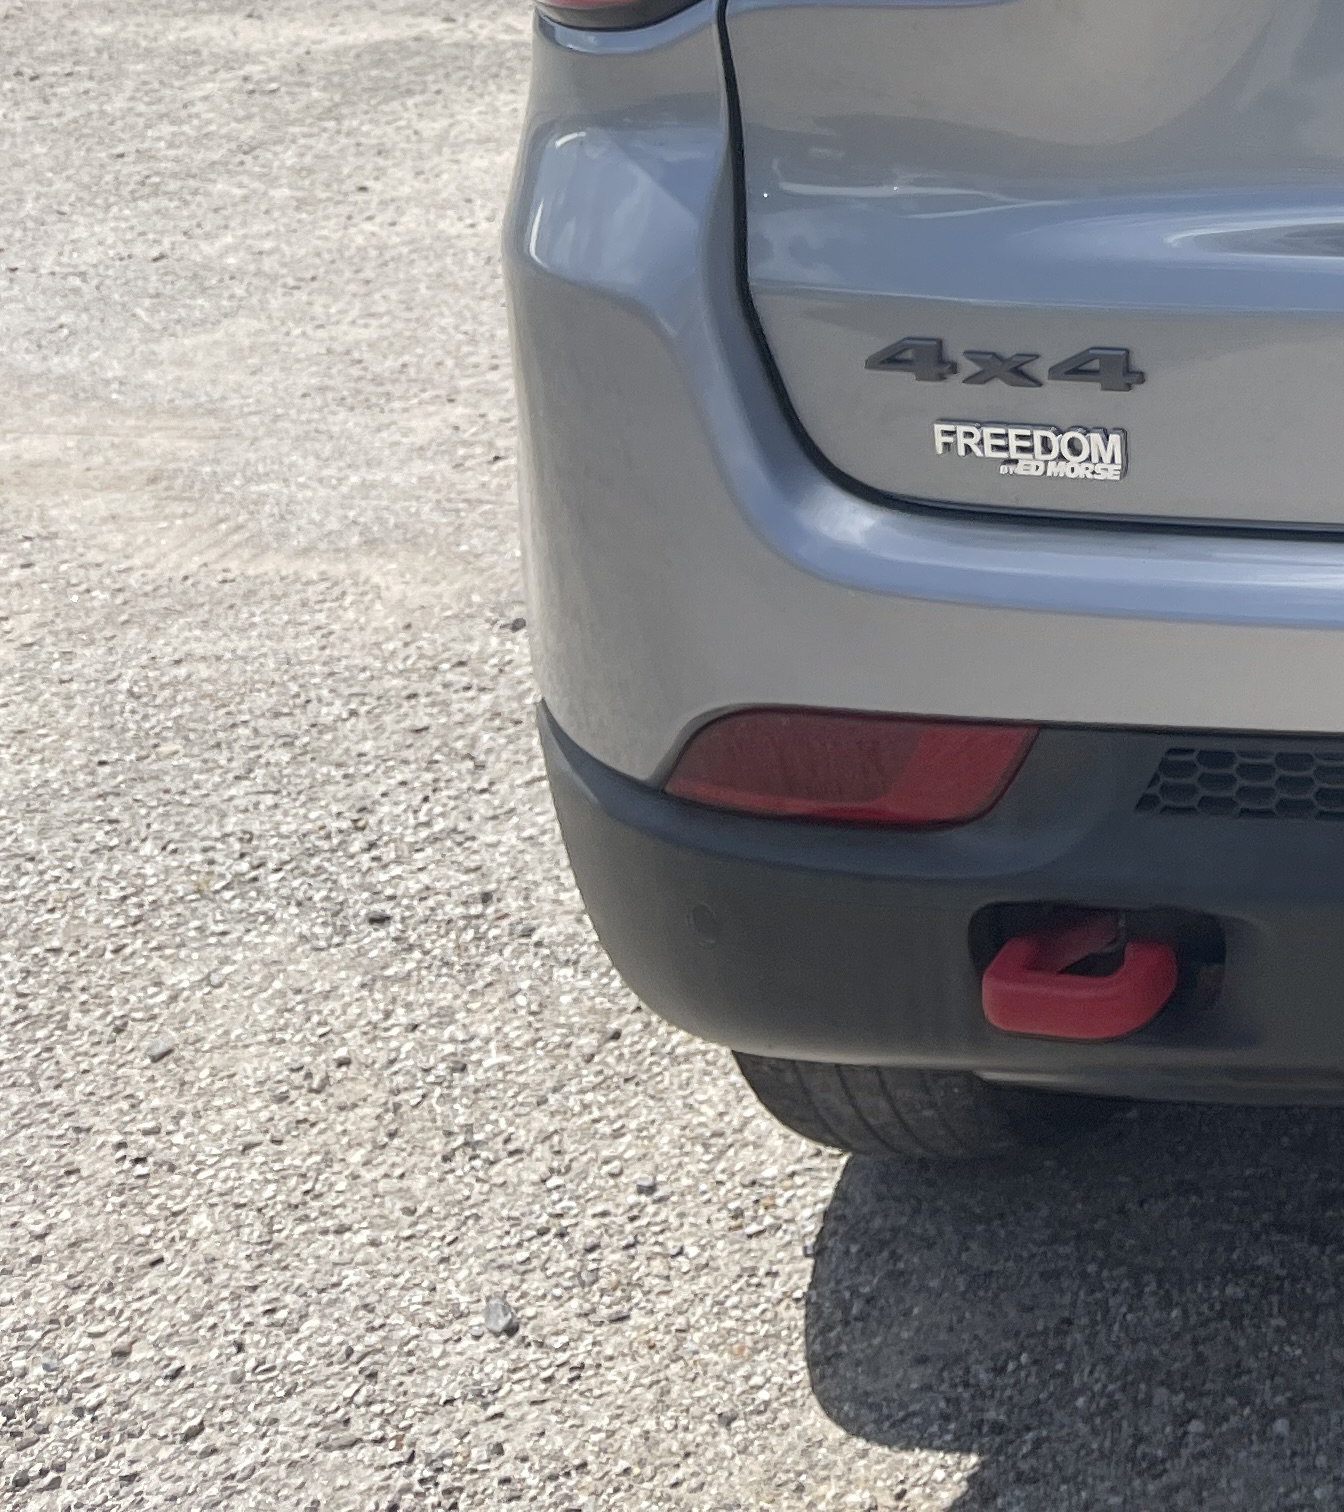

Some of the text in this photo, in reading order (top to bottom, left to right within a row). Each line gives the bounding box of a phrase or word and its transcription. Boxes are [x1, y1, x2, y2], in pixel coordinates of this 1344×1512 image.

[864, 336, 1147, 392] 4x4
[933, 420, 1127, 465] FREEDOM
[1014, 460, 1045, 476] ED
[1047, 461, 1122, 481] MORSE
